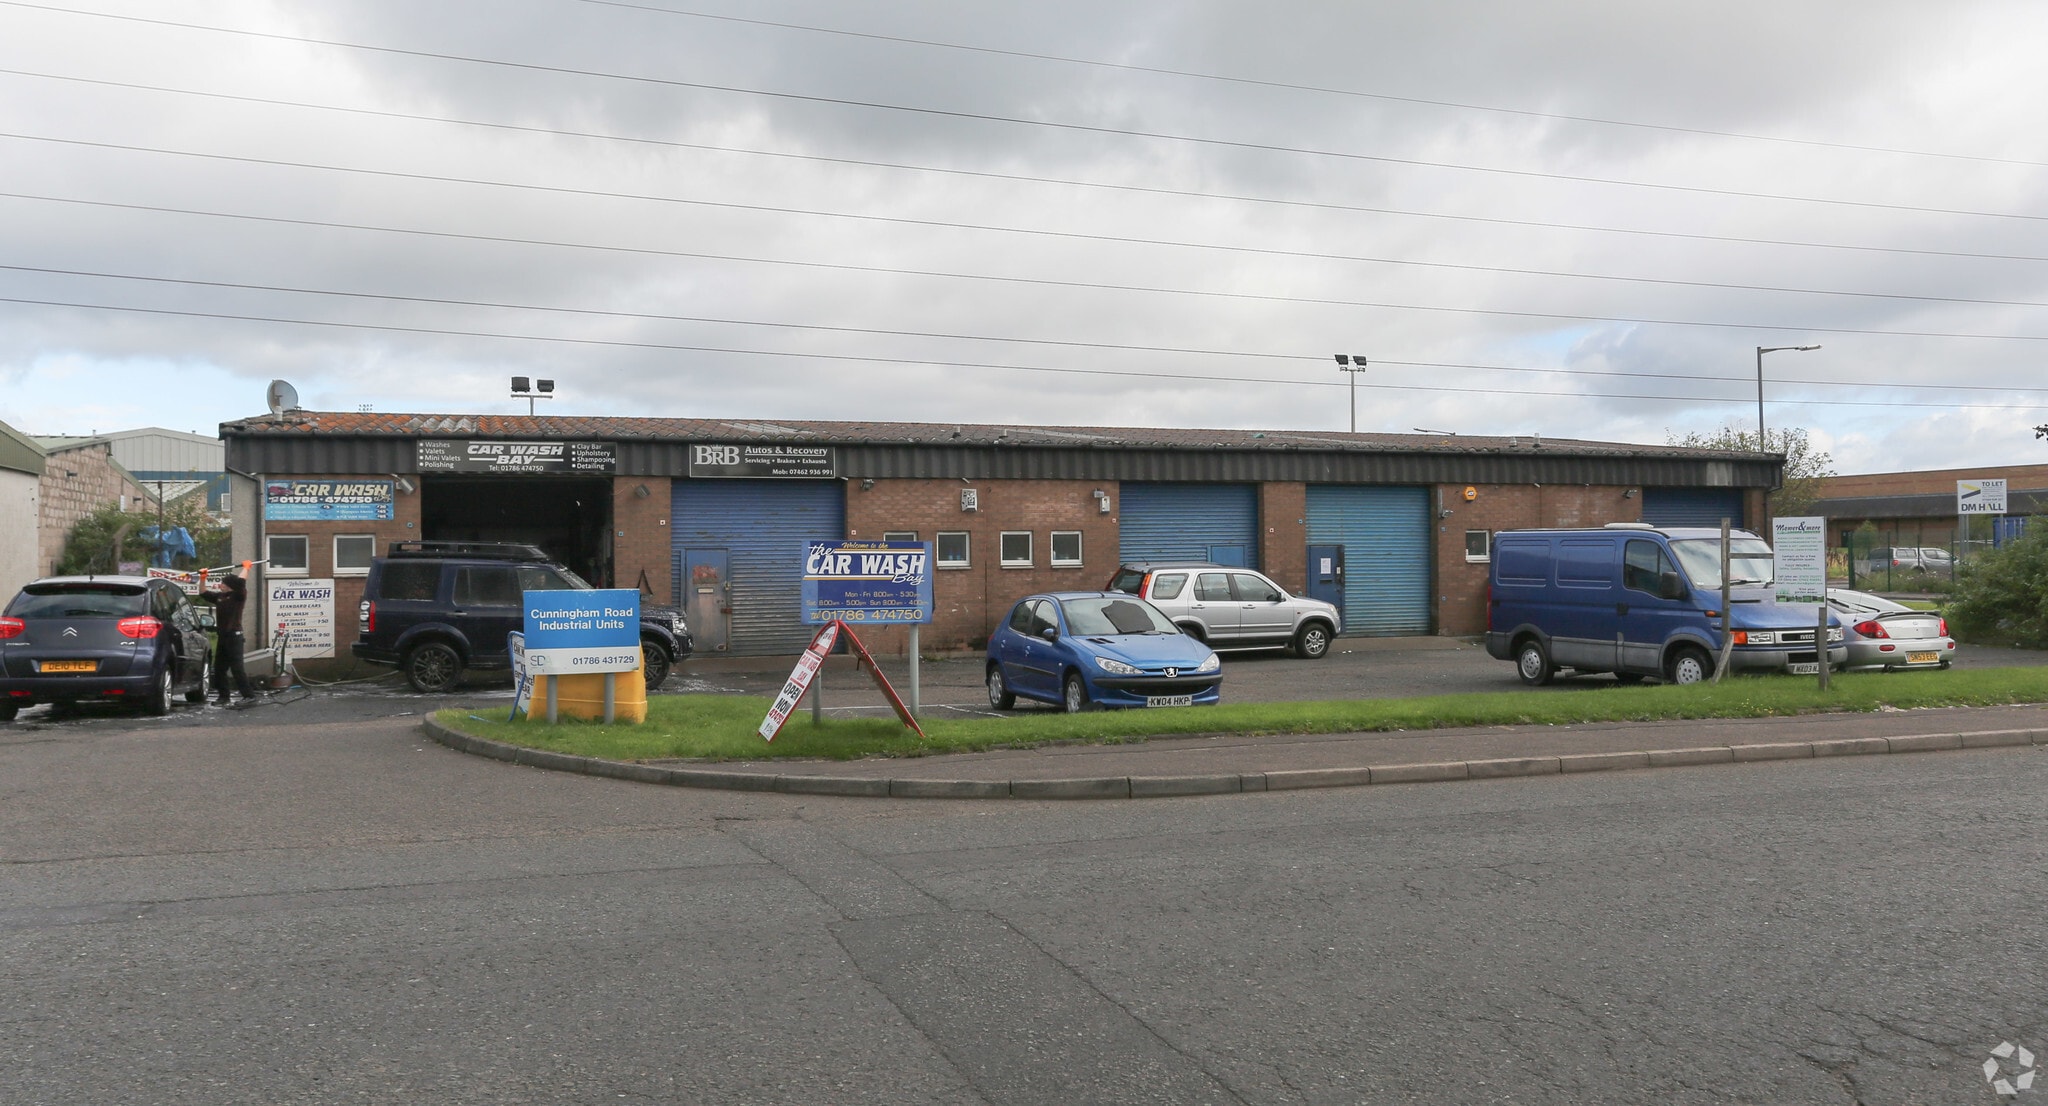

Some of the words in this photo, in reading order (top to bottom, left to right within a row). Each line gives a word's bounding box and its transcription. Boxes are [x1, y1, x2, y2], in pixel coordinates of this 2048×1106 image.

[467, 445, 503, 455] CAR
[510, 445, 564, 455] WASH
[786, 447, 828, 455] Recovery
[496, 455, 535, 464] BAY
[294, 484, 330, 496] CAR
[334, 484, 388, 496] WASH
[808, 543, 834, 556] the
[806, 555, 852, 574] CAR
[861, 555, 926, 574] WASH
[892, 573, 924, 585] Bay
[273, 590, 295, 599] CAR
[300, 590, 331, 599] WASH
[531, 609, 600, 620] Cunningham
[604, 608, 633, 617] Road
[822, 610, 864, 620] 01786
[872, 610, 923, 620] 474750
[540, 620, 591, 630] Industrial
[596, 620, 624, 629] Units
[573, 656, 600, 665] 01786
[602, 656, 634, 664] 431729
[783, 682, 802, 700] OPEN
[1174, 697, 1189, 705] HKP
